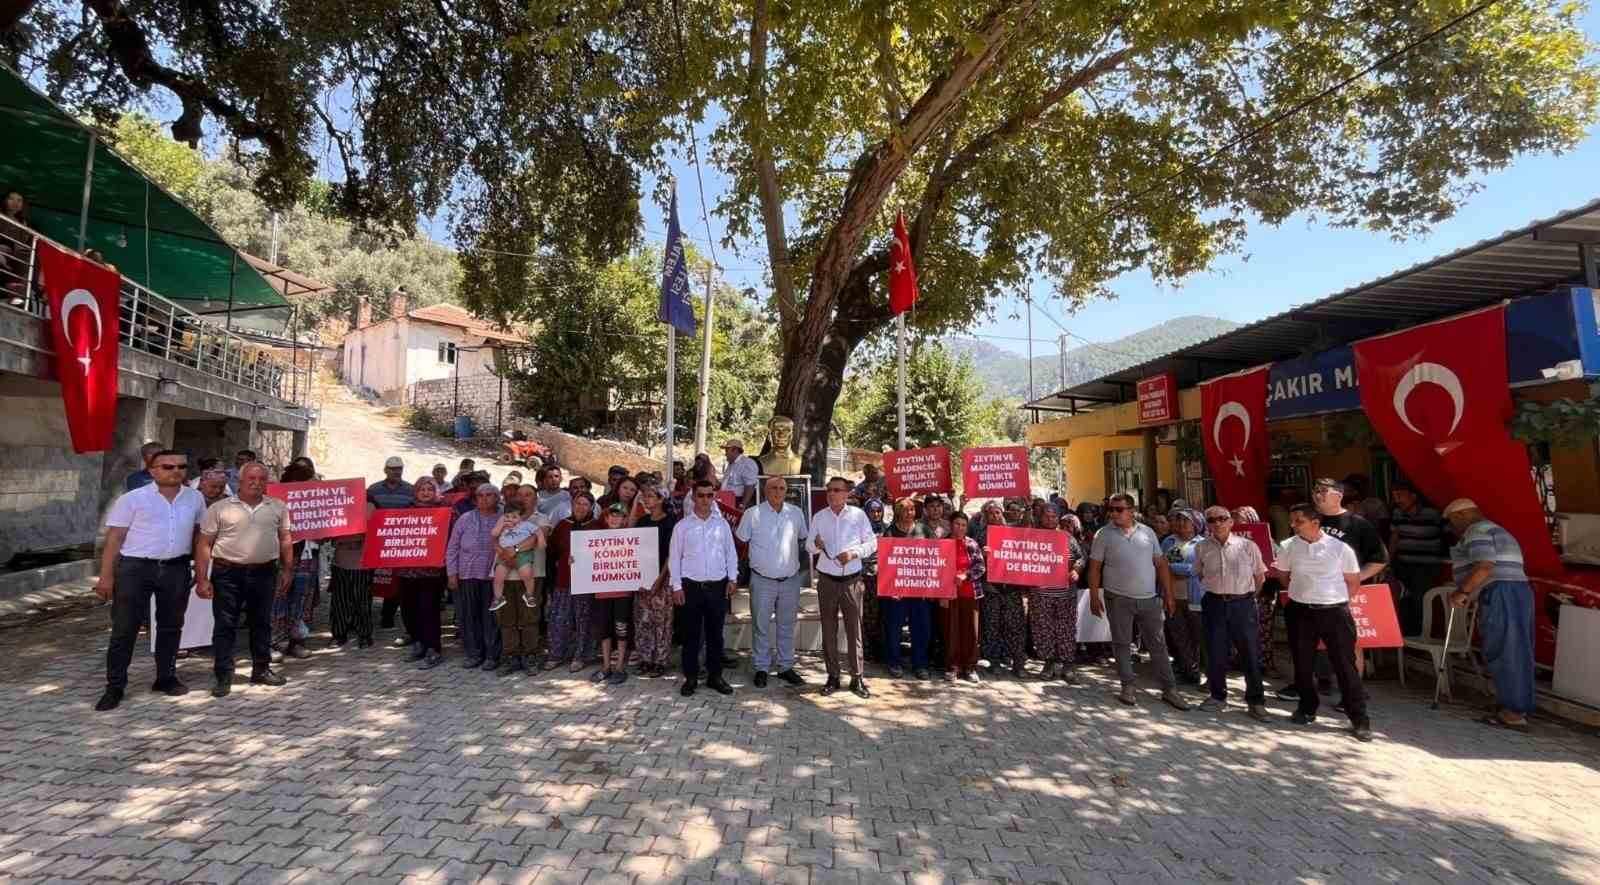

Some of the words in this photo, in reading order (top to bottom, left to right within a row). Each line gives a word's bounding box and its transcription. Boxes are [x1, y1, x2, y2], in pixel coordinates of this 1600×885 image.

[897, 456, 924, 464] ZEYTİN
[974, 453, 1002, 462] ZEYTİN
[893, 463, 941, 473] MADENCİLİK
[970, 462, 1020, 472] MADENCİLİK
[902, 472, 935, 481] BİRLİKTE
[979, 472, 1013, 480] BİRLİKTE
[901, 480, 938, 490] MÜMKÜN
[978, 480, 1016, 490] MÜMKÜN
[288, 488, 328, 499] ZEYTİN
[331, 486, 346, 495] VE
[293, 508, 344, 520] BİRLİKTE
[290, 517, 348, 531] MÜMKÜN
[384, 516, 418, 525] ZEYTİN
[420, 516, 432, 524] VE
[377, 526, 438, 536] MADENCİLİK
[384, 537, 427, 546] BİRLİKTE
[588, 536, 624, 547] ZEYTİN
[628, 537, 640, 545] VE
[1002, 540, 1038, 549] ZEYTİN
[1040, 543, 1052, 551] DE
[380, 547, 427, 557] MÜMKÜN
[893, 546, 925, 554] ZEYTİN
[994, 549, 1022, 560] BİZİM
[1024, 553, 1064, 564] KÖMÜR
[593, 560, 638, 570] BİRLİKTE
[888, 557, 946, 567] MADENCİLİK
[897, 566, 937, 577] BİRLİKTE
[1007, 563, 1020, 571] DE
[1022, 563, 1050, 574] BİZİM
[592, 571, 641, 582] MÜMKÜN
[894, 577, 940, 588] MÜMKÜN
